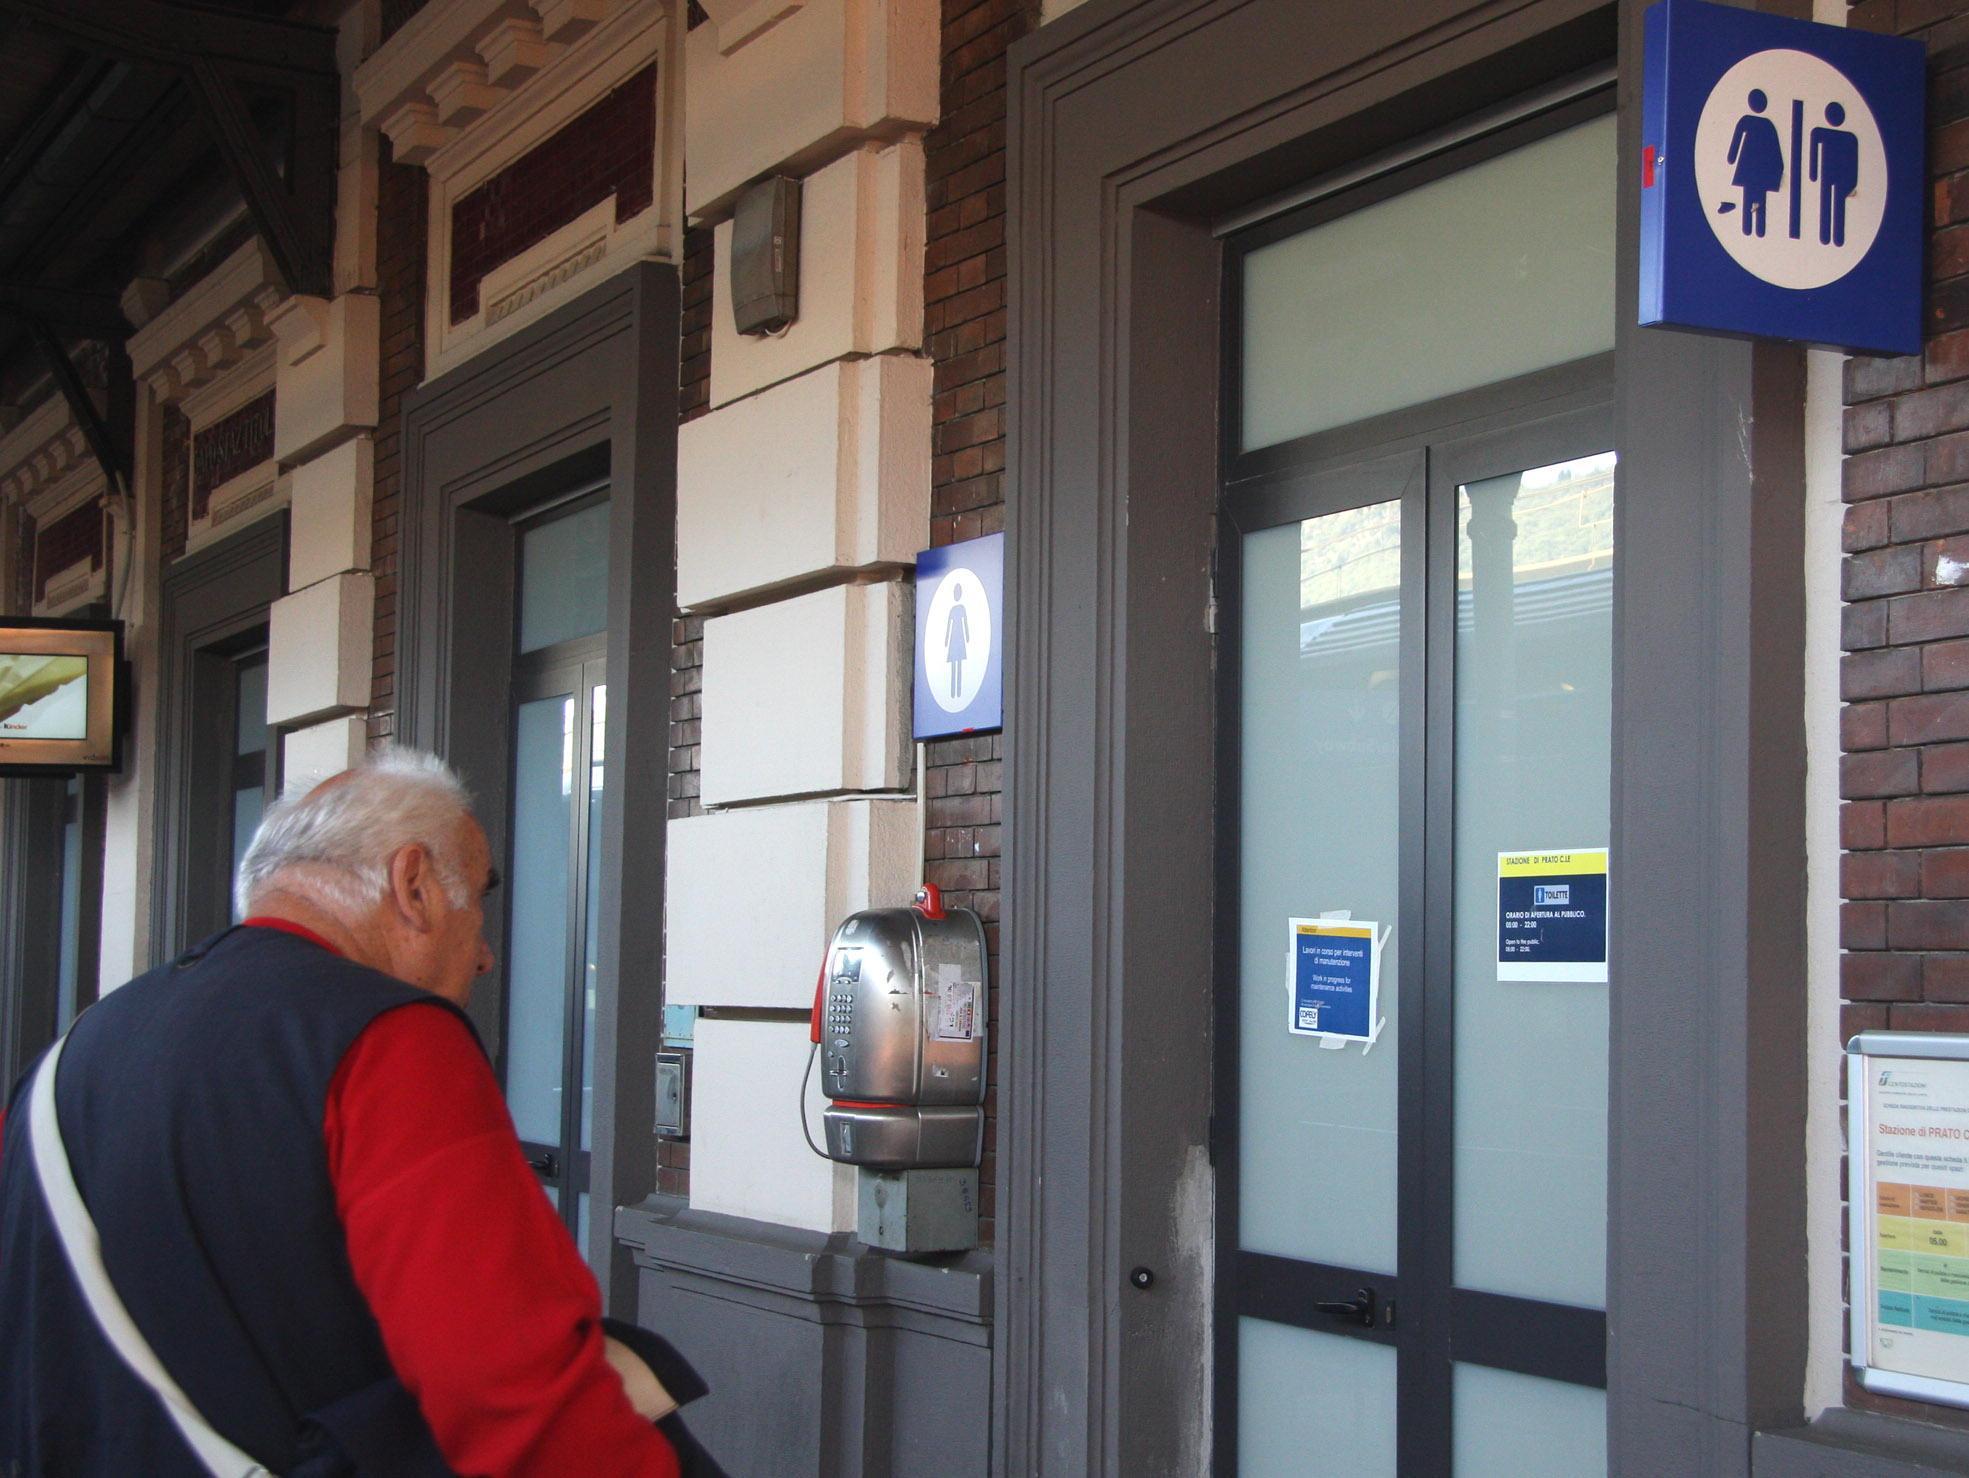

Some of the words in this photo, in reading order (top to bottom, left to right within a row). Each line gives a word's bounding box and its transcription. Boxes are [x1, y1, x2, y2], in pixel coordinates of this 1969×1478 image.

[1506, 856, 1530, 865] STAZIONE
[1533, 856, 1540, 864] DI
[1541, 855, 1559, 864] PRATO
[1545, 890, 1568, 900] TOILETTE
[1505, 911, 1525, 919] ORARIO
[1530, 910, 1554, 918] APERTURA
[1554, 910, 1560, 918] AL
[1334, 949, 1343, 957] per
[1878, 1124, 1916, 1137] Stazione
[1918, 1127, 1926, 1137] di
[1928, 1127, 1961, 1139] PRATO
